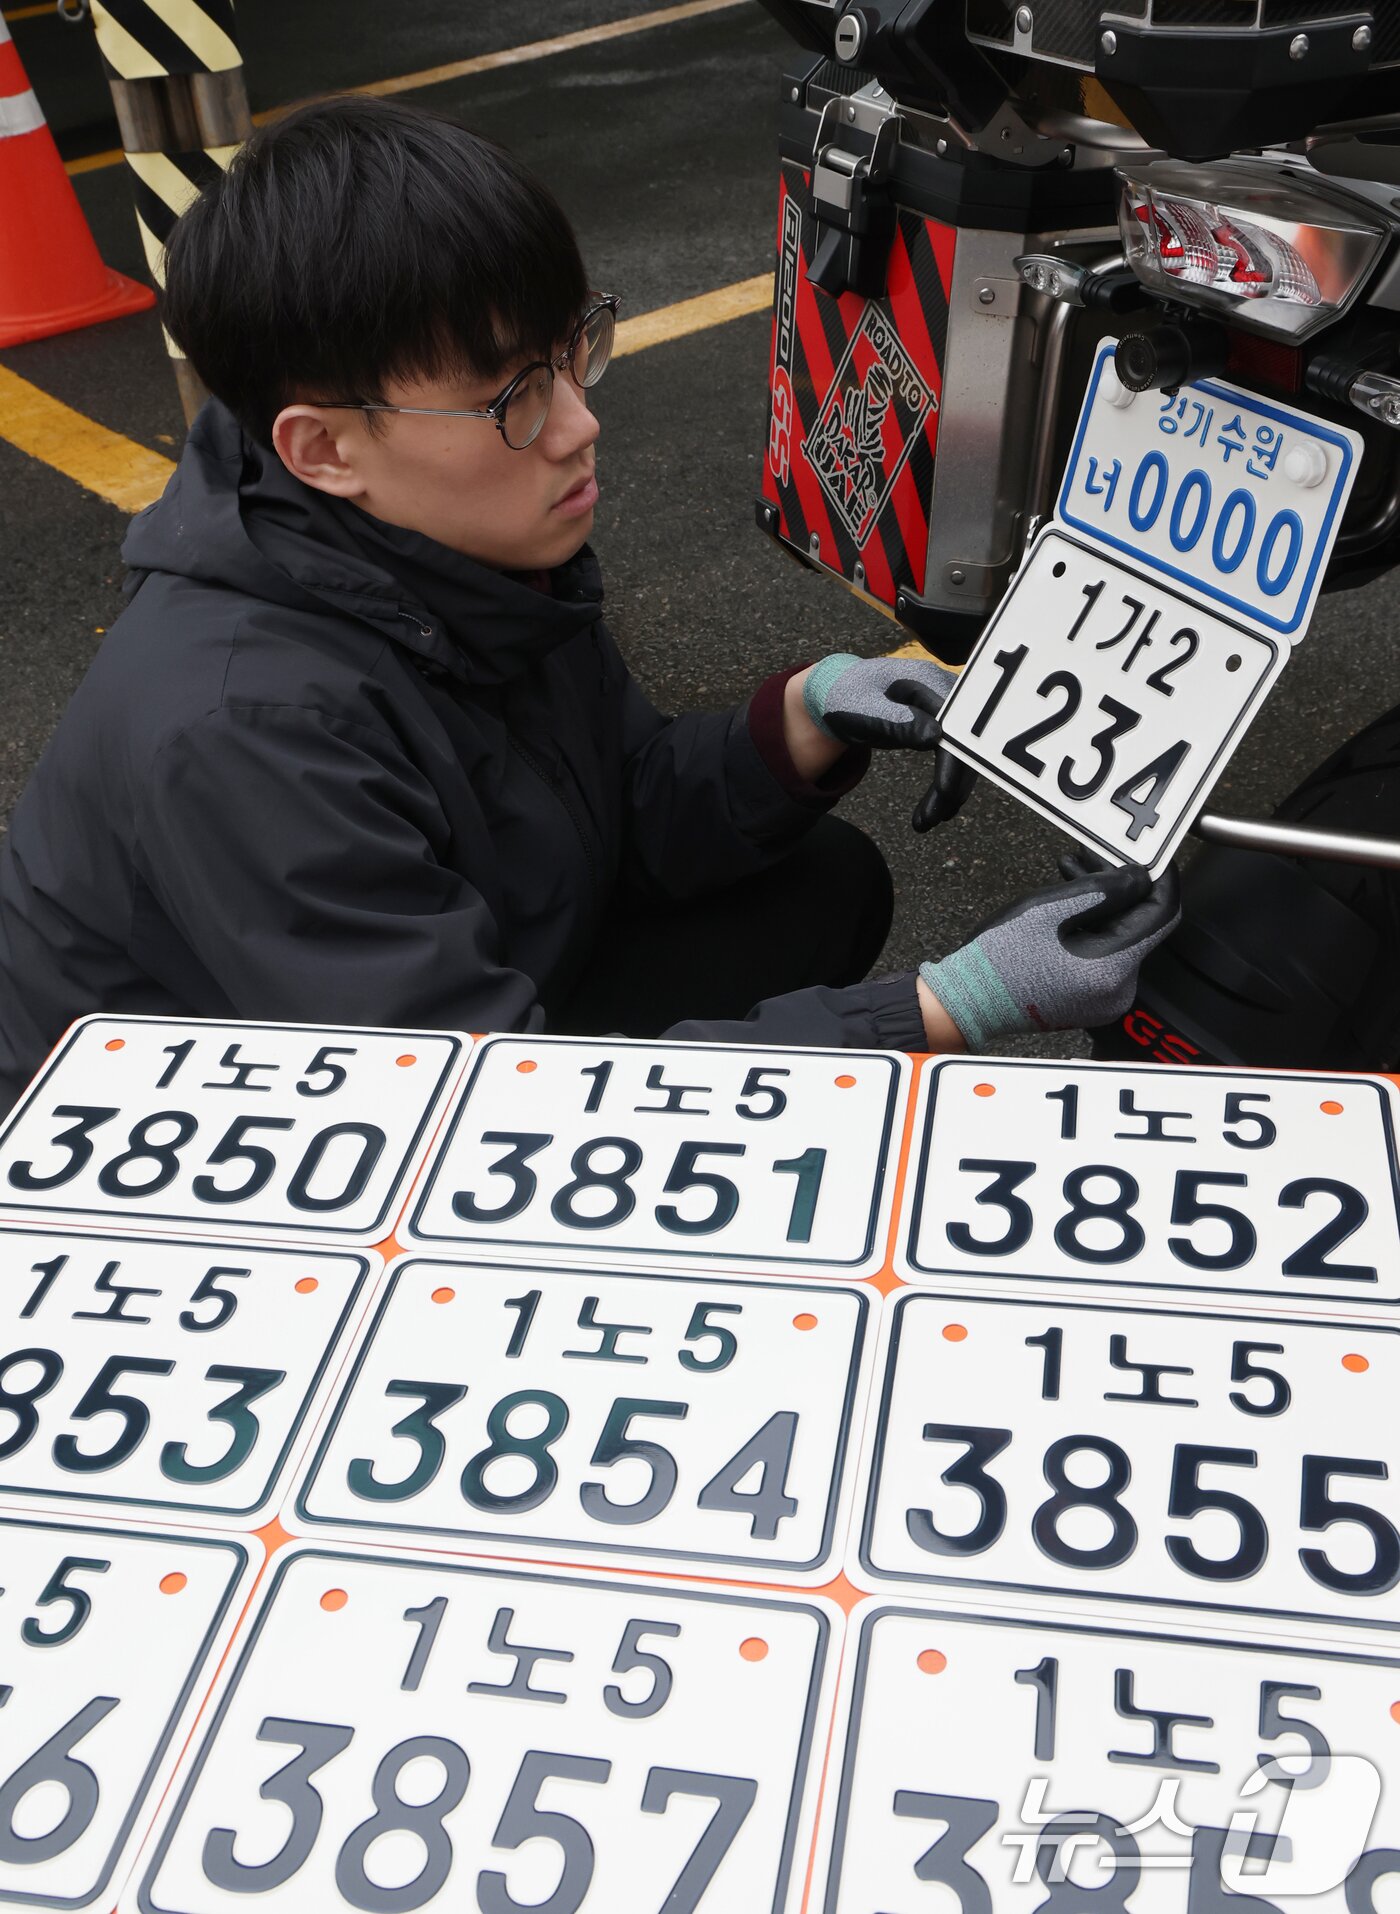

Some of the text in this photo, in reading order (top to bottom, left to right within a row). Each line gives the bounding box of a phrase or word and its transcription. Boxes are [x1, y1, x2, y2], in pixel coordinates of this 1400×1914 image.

[863, 312, 921, 411] ROAD TO
[814, 437, 867, 530] UAE
[825, 402, 875, 507] DAKAR
[971, 643, 1191, 842] 1234
[7, 1104, 387, 1213] 3850
[451, 1130, 828, 1243] 3851
[945, 1157, 1379, 1284] 3852
[346, 1378, 800, 1541] 3854
[905, 1422, 1400, 1598] 3855
[202, 1716, 759, 1914] 3857
